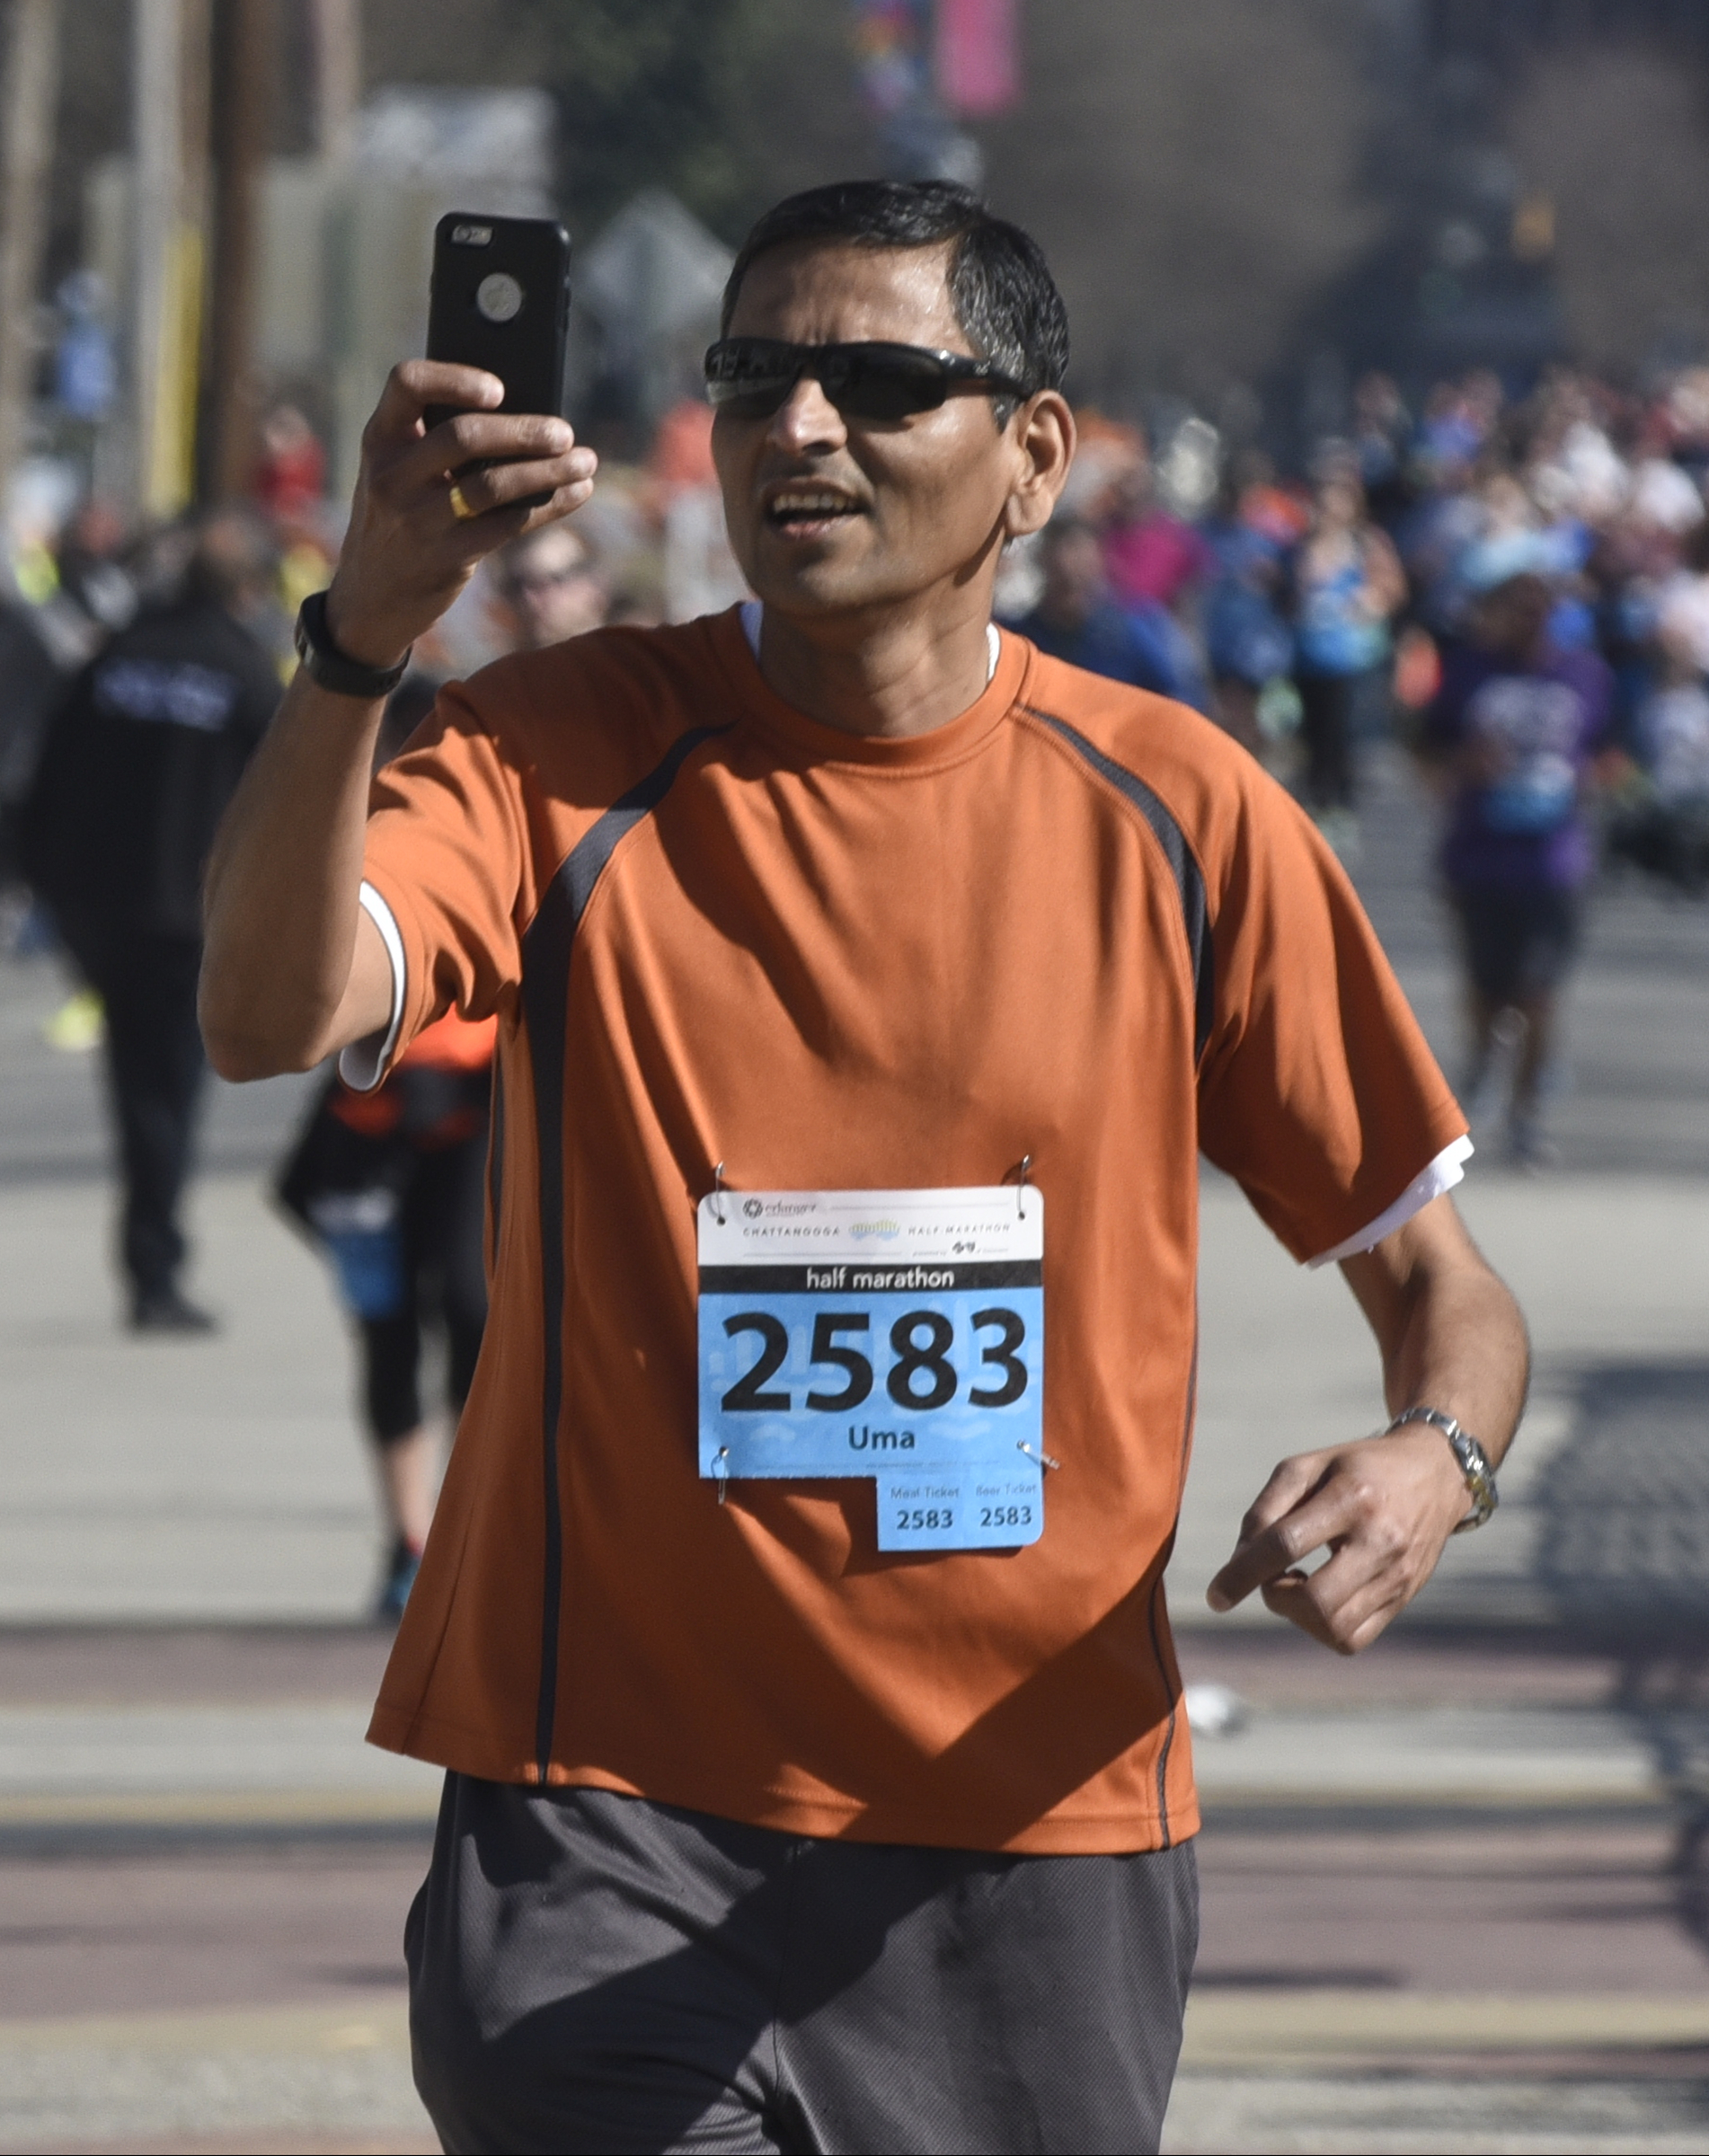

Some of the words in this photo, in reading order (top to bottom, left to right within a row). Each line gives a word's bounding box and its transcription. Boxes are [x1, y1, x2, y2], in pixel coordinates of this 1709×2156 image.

[743, 1227, 840, 1237] CHATTANOOGA
[908, 1226, 939, 1236] HALF
[945, 1224, 1010, 1234] MARATHON
[807, 1266, 847, 1289] half
[853, 1265, 955, 1289] marathon
[722, 1308, 1028, 1412] 2583
[848, 1427, 915, 1450] Uma
[890, 1488, 920, 1499] Meal
[925, 1487, 960, 1498] Ticket
[897, 1509, 953, 1530] 2583
[980, 1506, 1032, 1526] 2583
